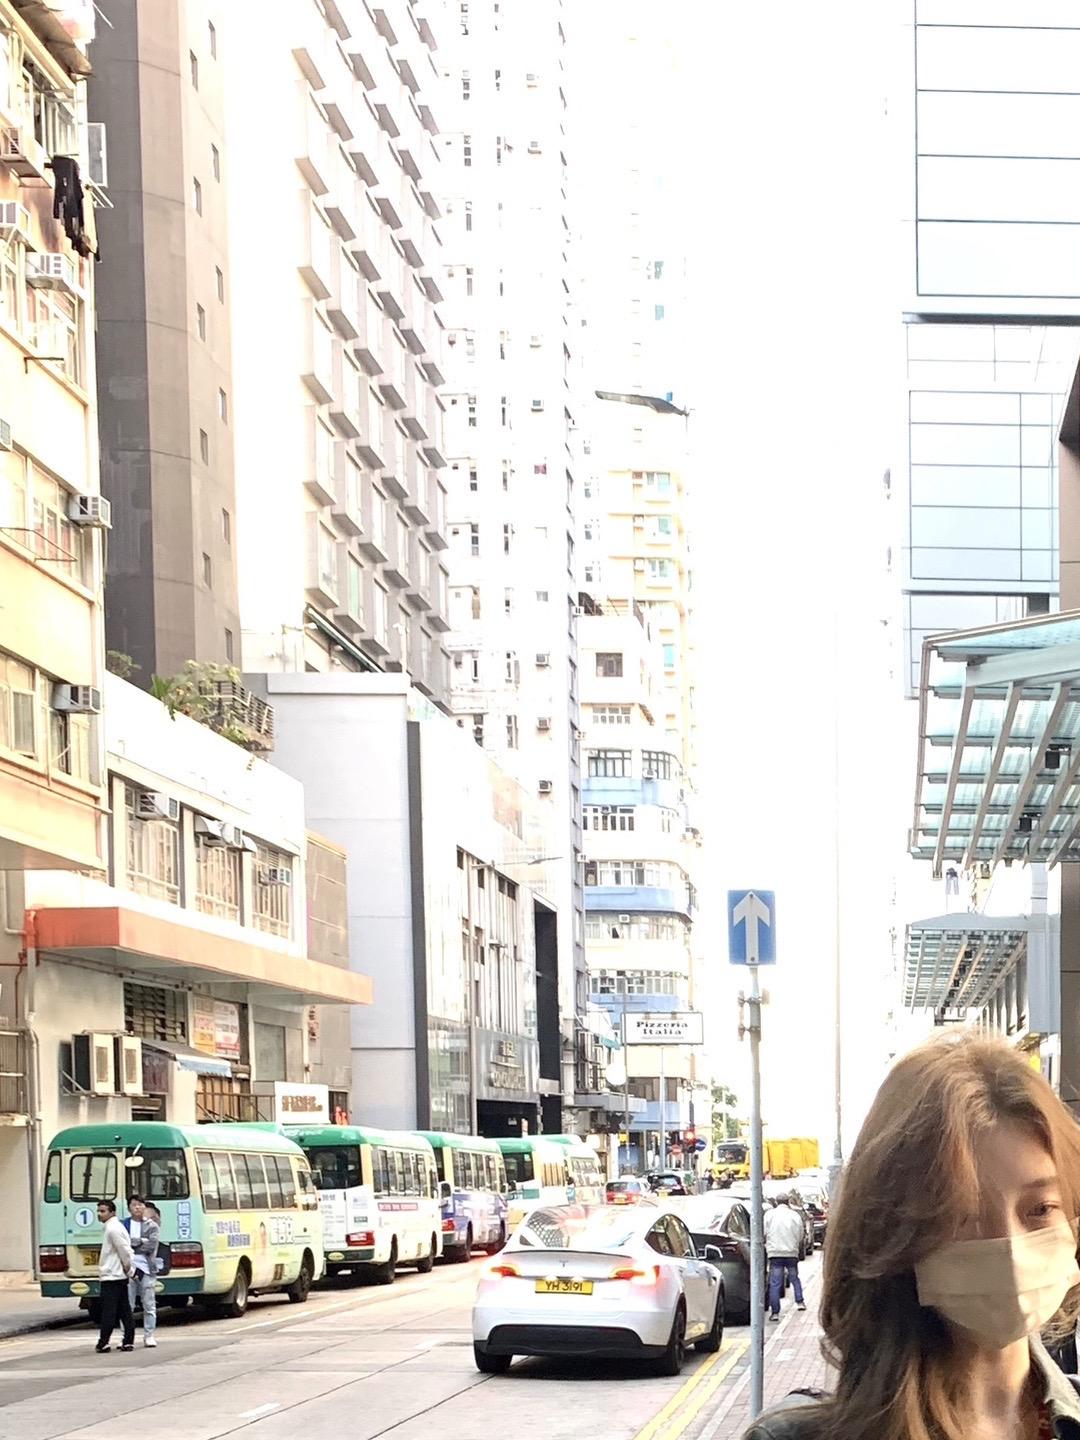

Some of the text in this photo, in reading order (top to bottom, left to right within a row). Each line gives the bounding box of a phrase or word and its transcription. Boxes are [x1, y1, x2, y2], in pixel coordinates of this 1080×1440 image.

[80, 1210, 87, 1225] 1
[545, 1280, 583, 1291] YH 3191
